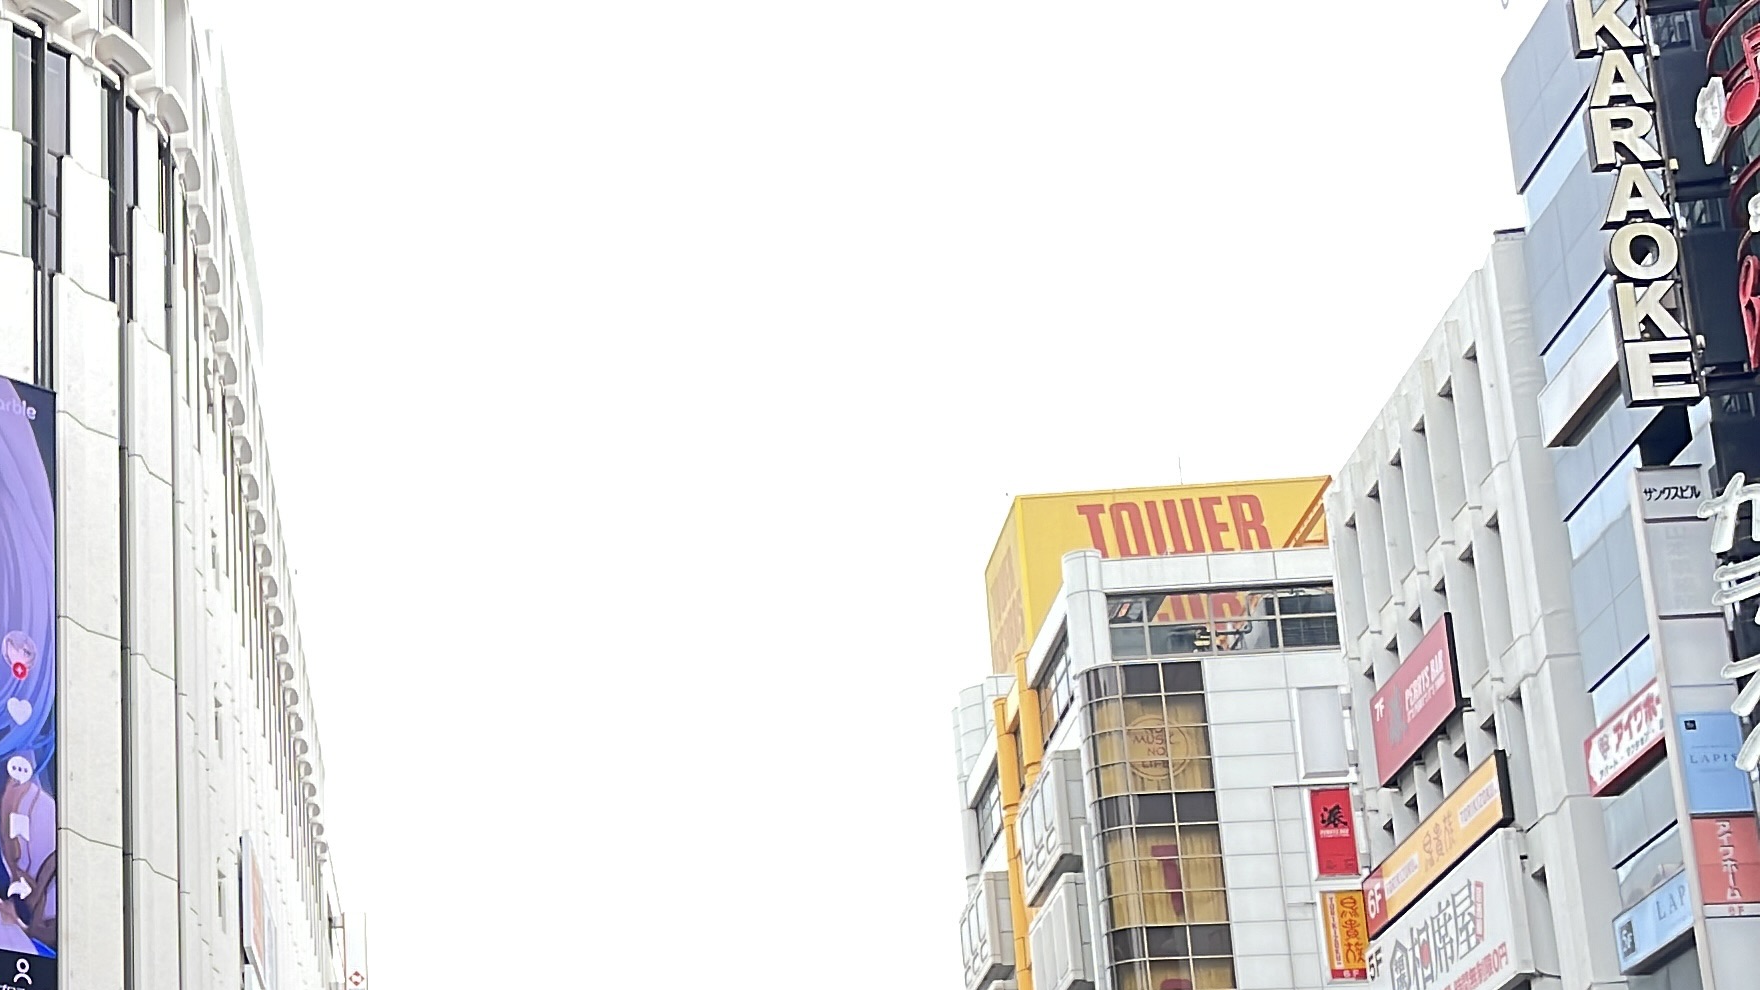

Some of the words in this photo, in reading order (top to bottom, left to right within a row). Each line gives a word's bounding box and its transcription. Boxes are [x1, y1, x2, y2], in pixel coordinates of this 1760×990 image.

[1573, 0, 1703, 402] KARAOKE
[1643, 485, 1701, 500] サンクスビル
[1076, 494, 1273, 559] TOWER
[1374, 698, 1385, 722] 7F
[1147, 747, 1167, 757] NO
[1367, 884, 1384, 919] 6F
[1368, 947, 1384, 981] 5F
